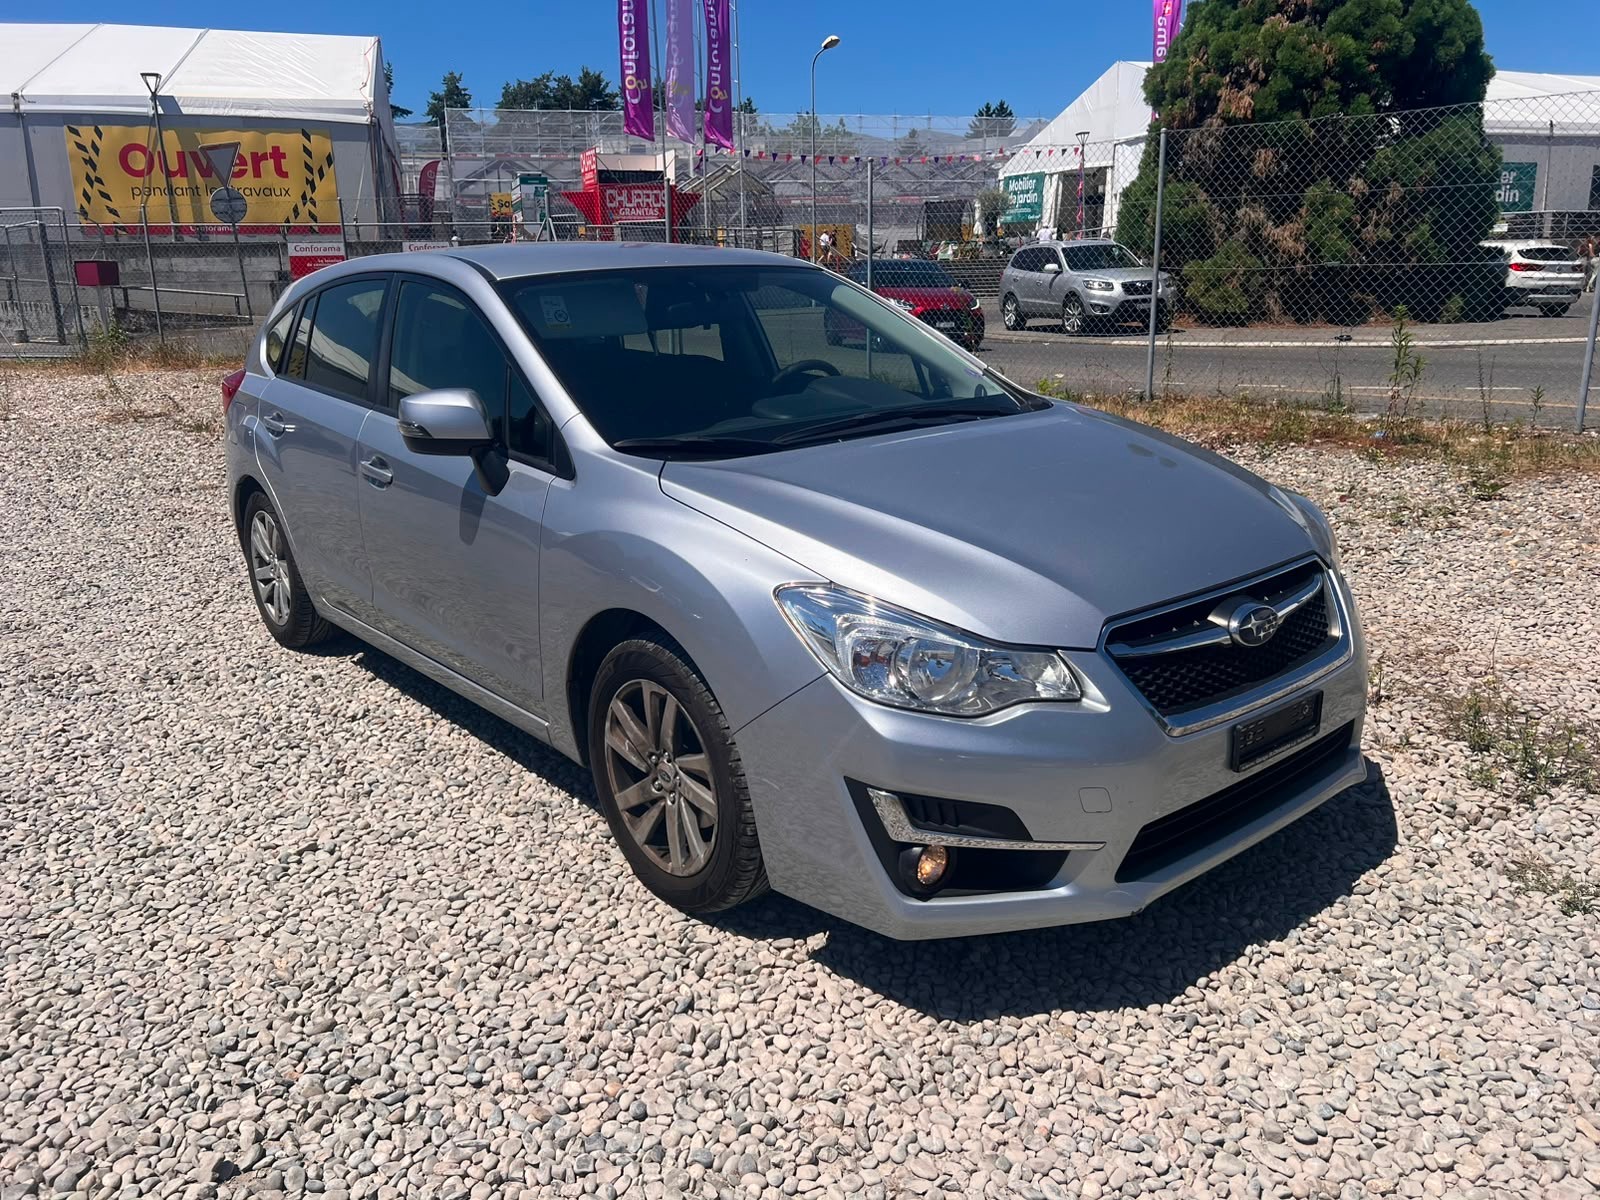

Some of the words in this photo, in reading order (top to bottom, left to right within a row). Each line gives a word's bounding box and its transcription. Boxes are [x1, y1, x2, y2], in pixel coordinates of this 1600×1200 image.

[118, 142, 289, 178] Ouvert
[1008, 175, 1036, 191] Mobilier
[130, 183, 201, 201] pendant
[1016, 189, 1038, 208] jardin
[619, 207, 660, 217] GRANITAS
[294, 244, 342, 253] Conforama
